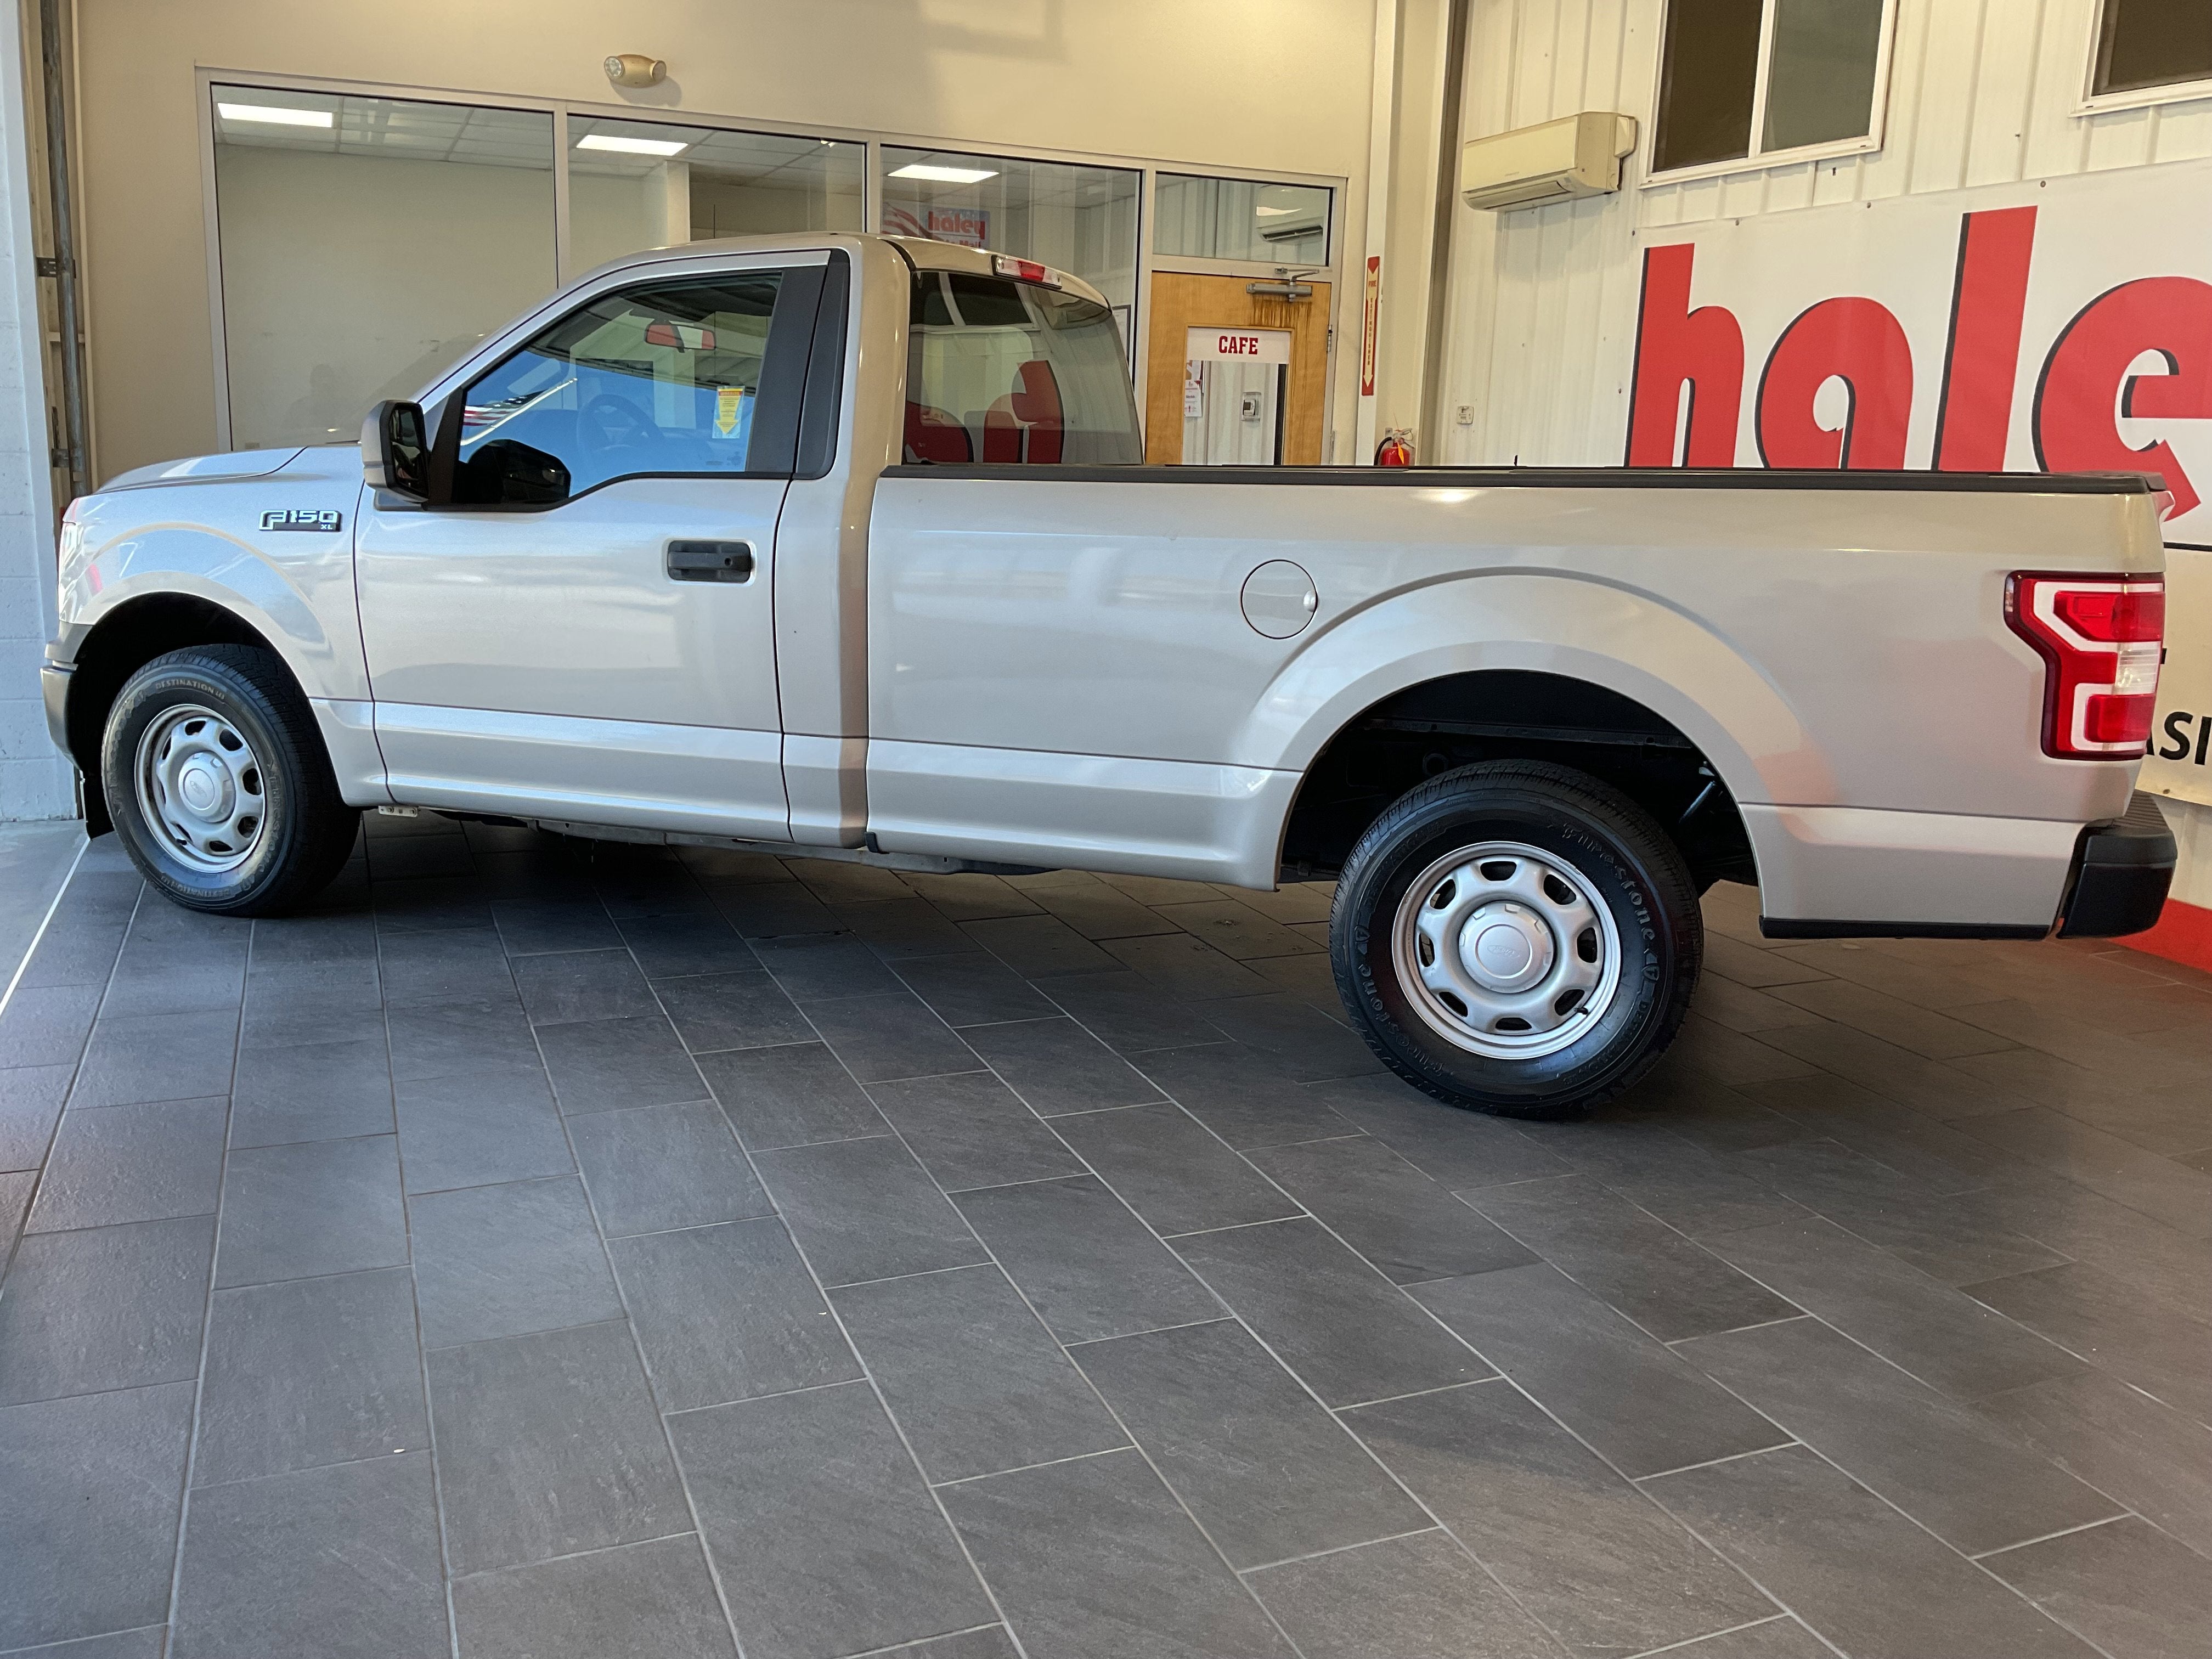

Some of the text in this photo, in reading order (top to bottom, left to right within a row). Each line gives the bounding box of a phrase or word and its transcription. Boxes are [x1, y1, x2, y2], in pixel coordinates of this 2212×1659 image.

[928, 211, 985, 240] haley
[1218, 335, 1259, 355] CAFE
[156, 678, 215, 694] DESTINATION
[2146, 711, 2212, 765] SI
